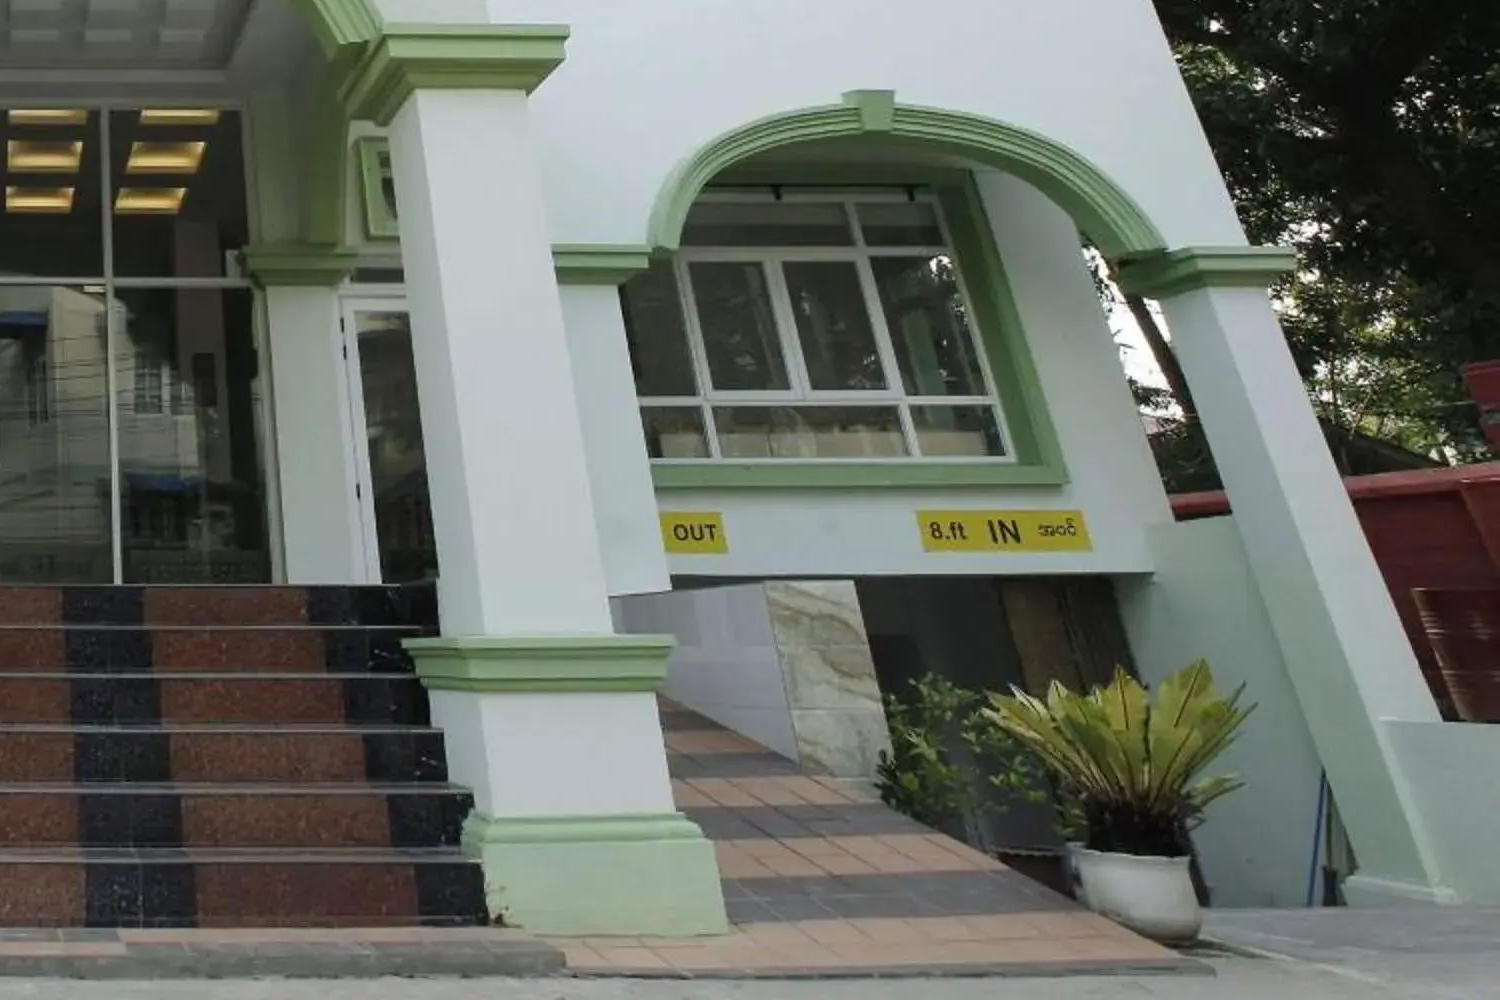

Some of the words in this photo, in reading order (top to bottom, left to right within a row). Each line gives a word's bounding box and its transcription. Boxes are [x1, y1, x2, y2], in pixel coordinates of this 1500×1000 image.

[673, 523, 717, 543] OUT
[929, 521, 968, 541] 8.ft
[987, 519, 1022, 545] IN
